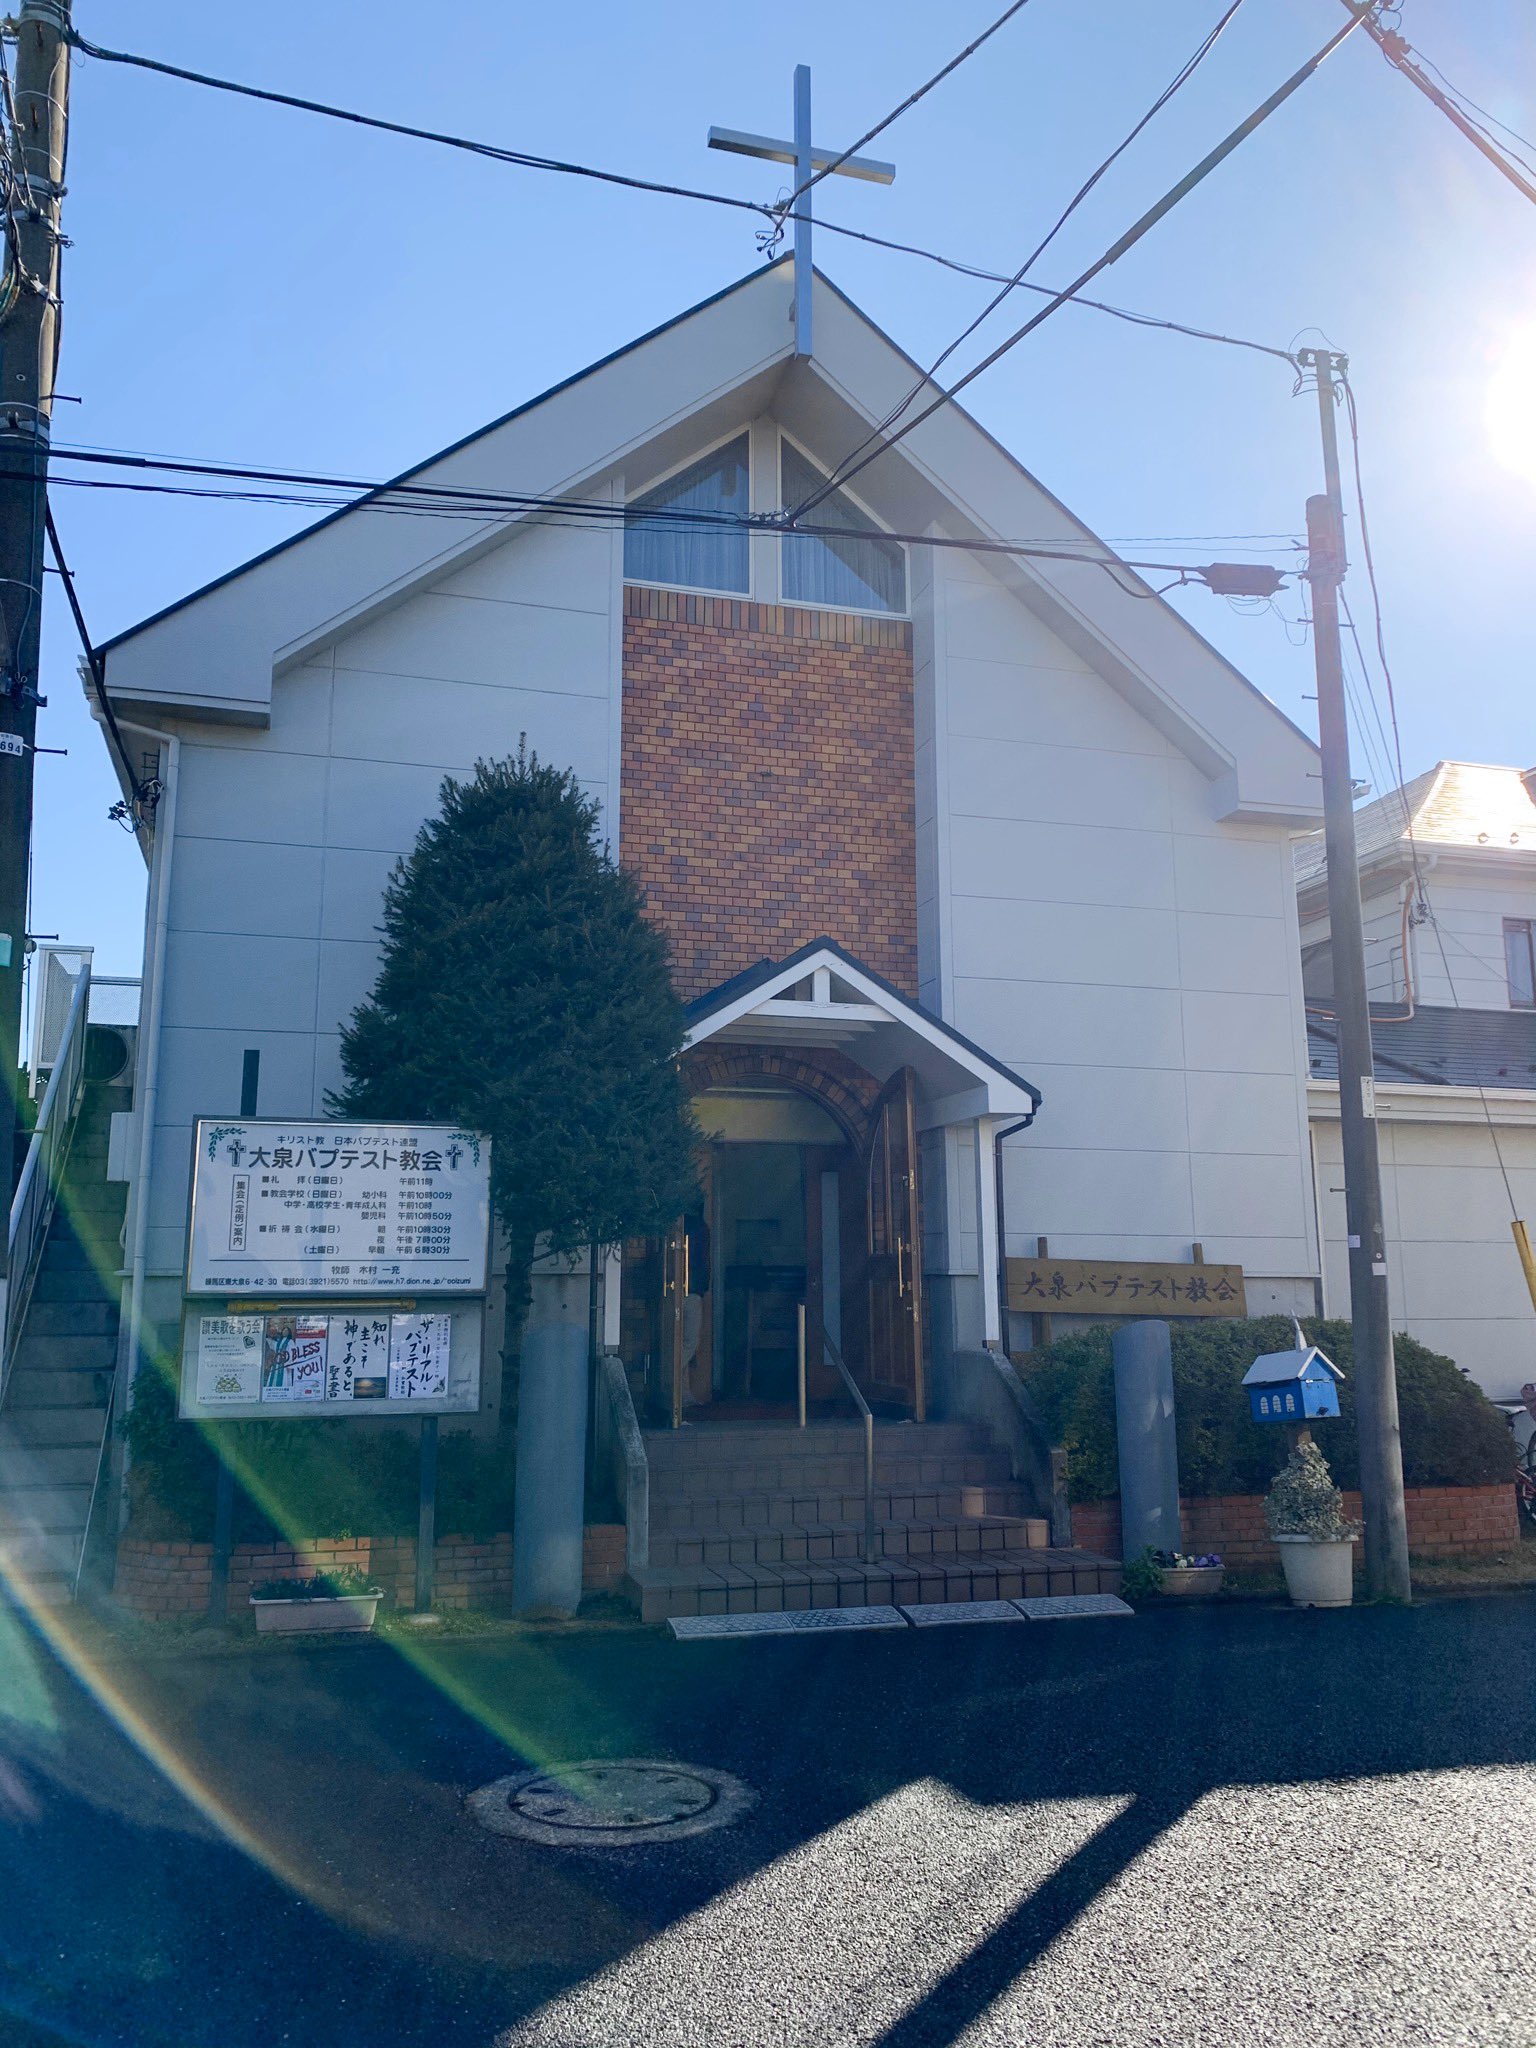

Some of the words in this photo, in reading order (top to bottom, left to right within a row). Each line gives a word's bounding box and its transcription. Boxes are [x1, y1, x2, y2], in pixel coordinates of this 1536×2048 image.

[277, 1135, 325, 1145] キリスト教
[248, 1146, 442, 1171] 大泉バプテスト教会
[1022, 1271, 1238, 1303] 大泉バプテスト教会
[405, 1330, 422, 1398] バプテスト
[328, 1365, 341, 1398] 聖書
